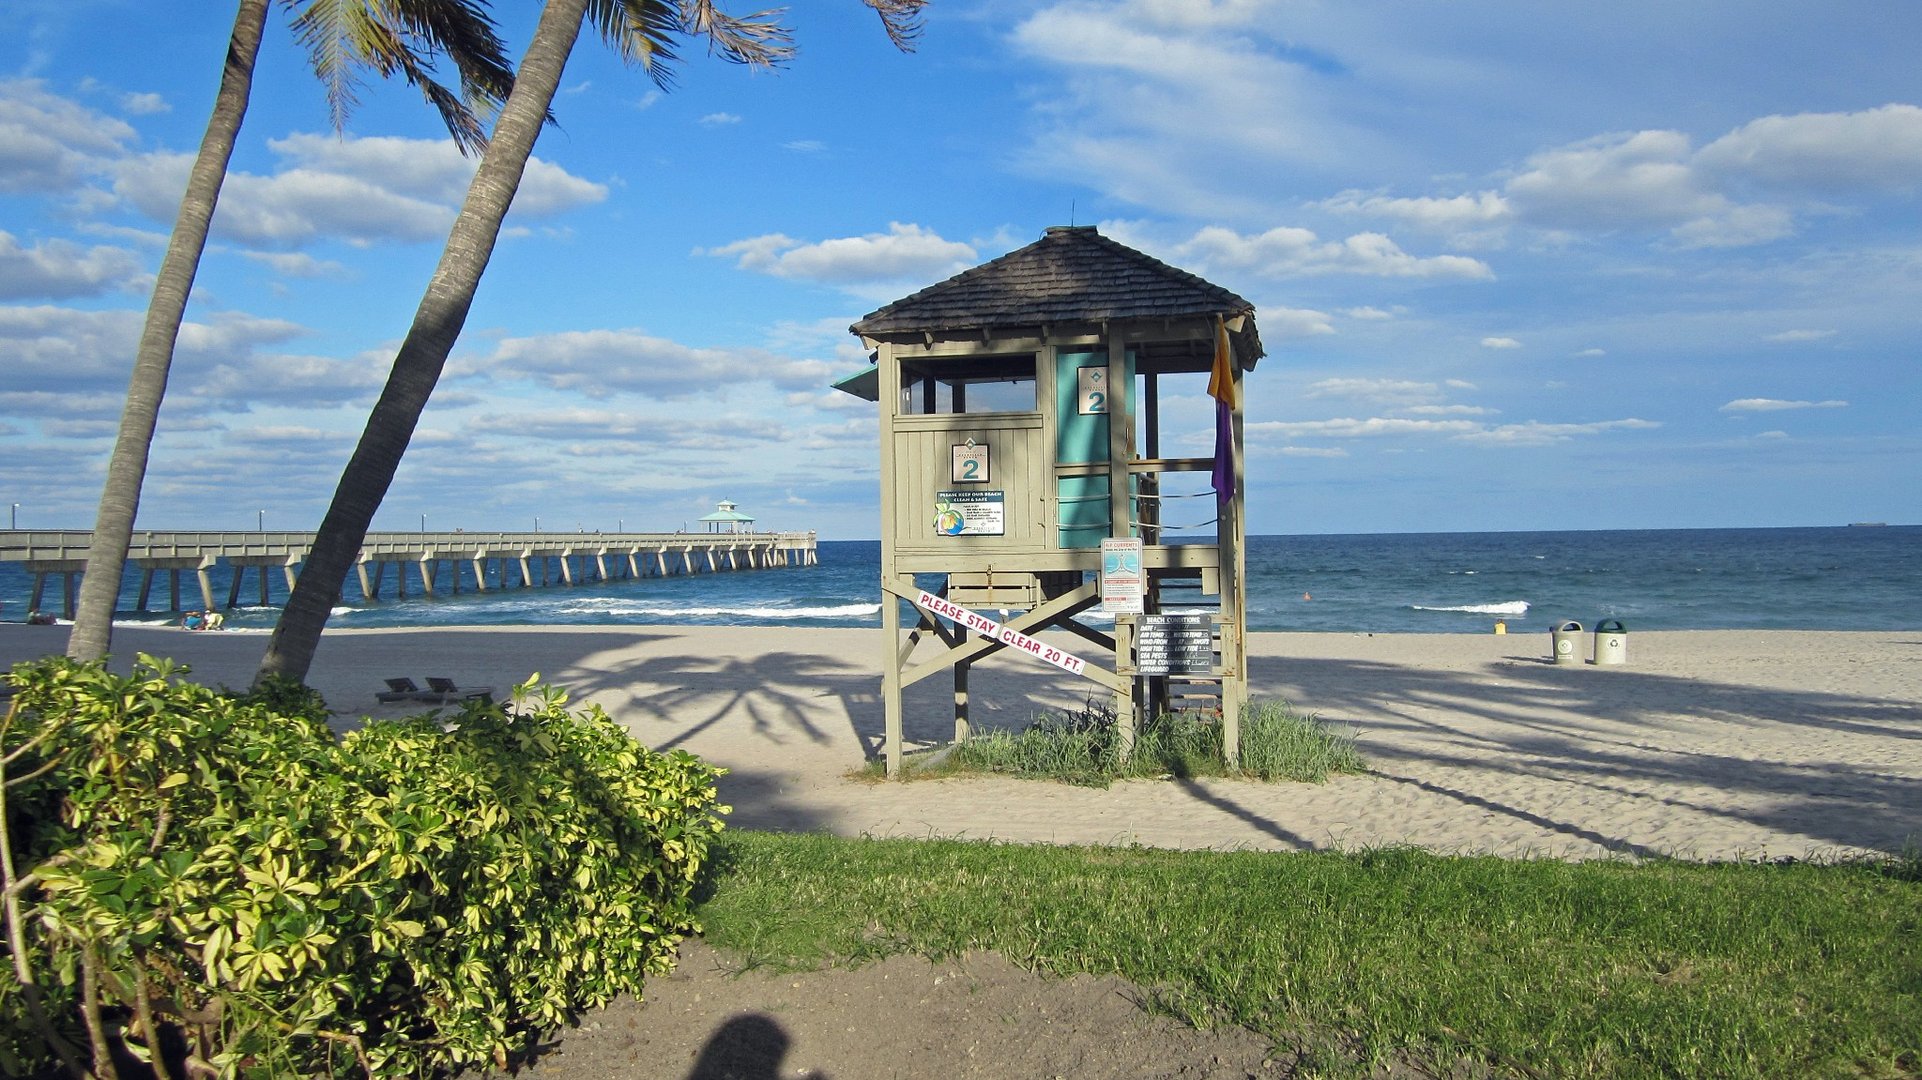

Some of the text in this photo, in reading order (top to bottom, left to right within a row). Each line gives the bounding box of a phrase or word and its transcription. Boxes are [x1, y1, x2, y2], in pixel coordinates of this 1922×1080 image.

[1089, 392, 1105, 411] 2
[962, 459, 979, 480] 2
[921, 594, 1080, 672] PLEASE STAY CLEAR 20 FT.
